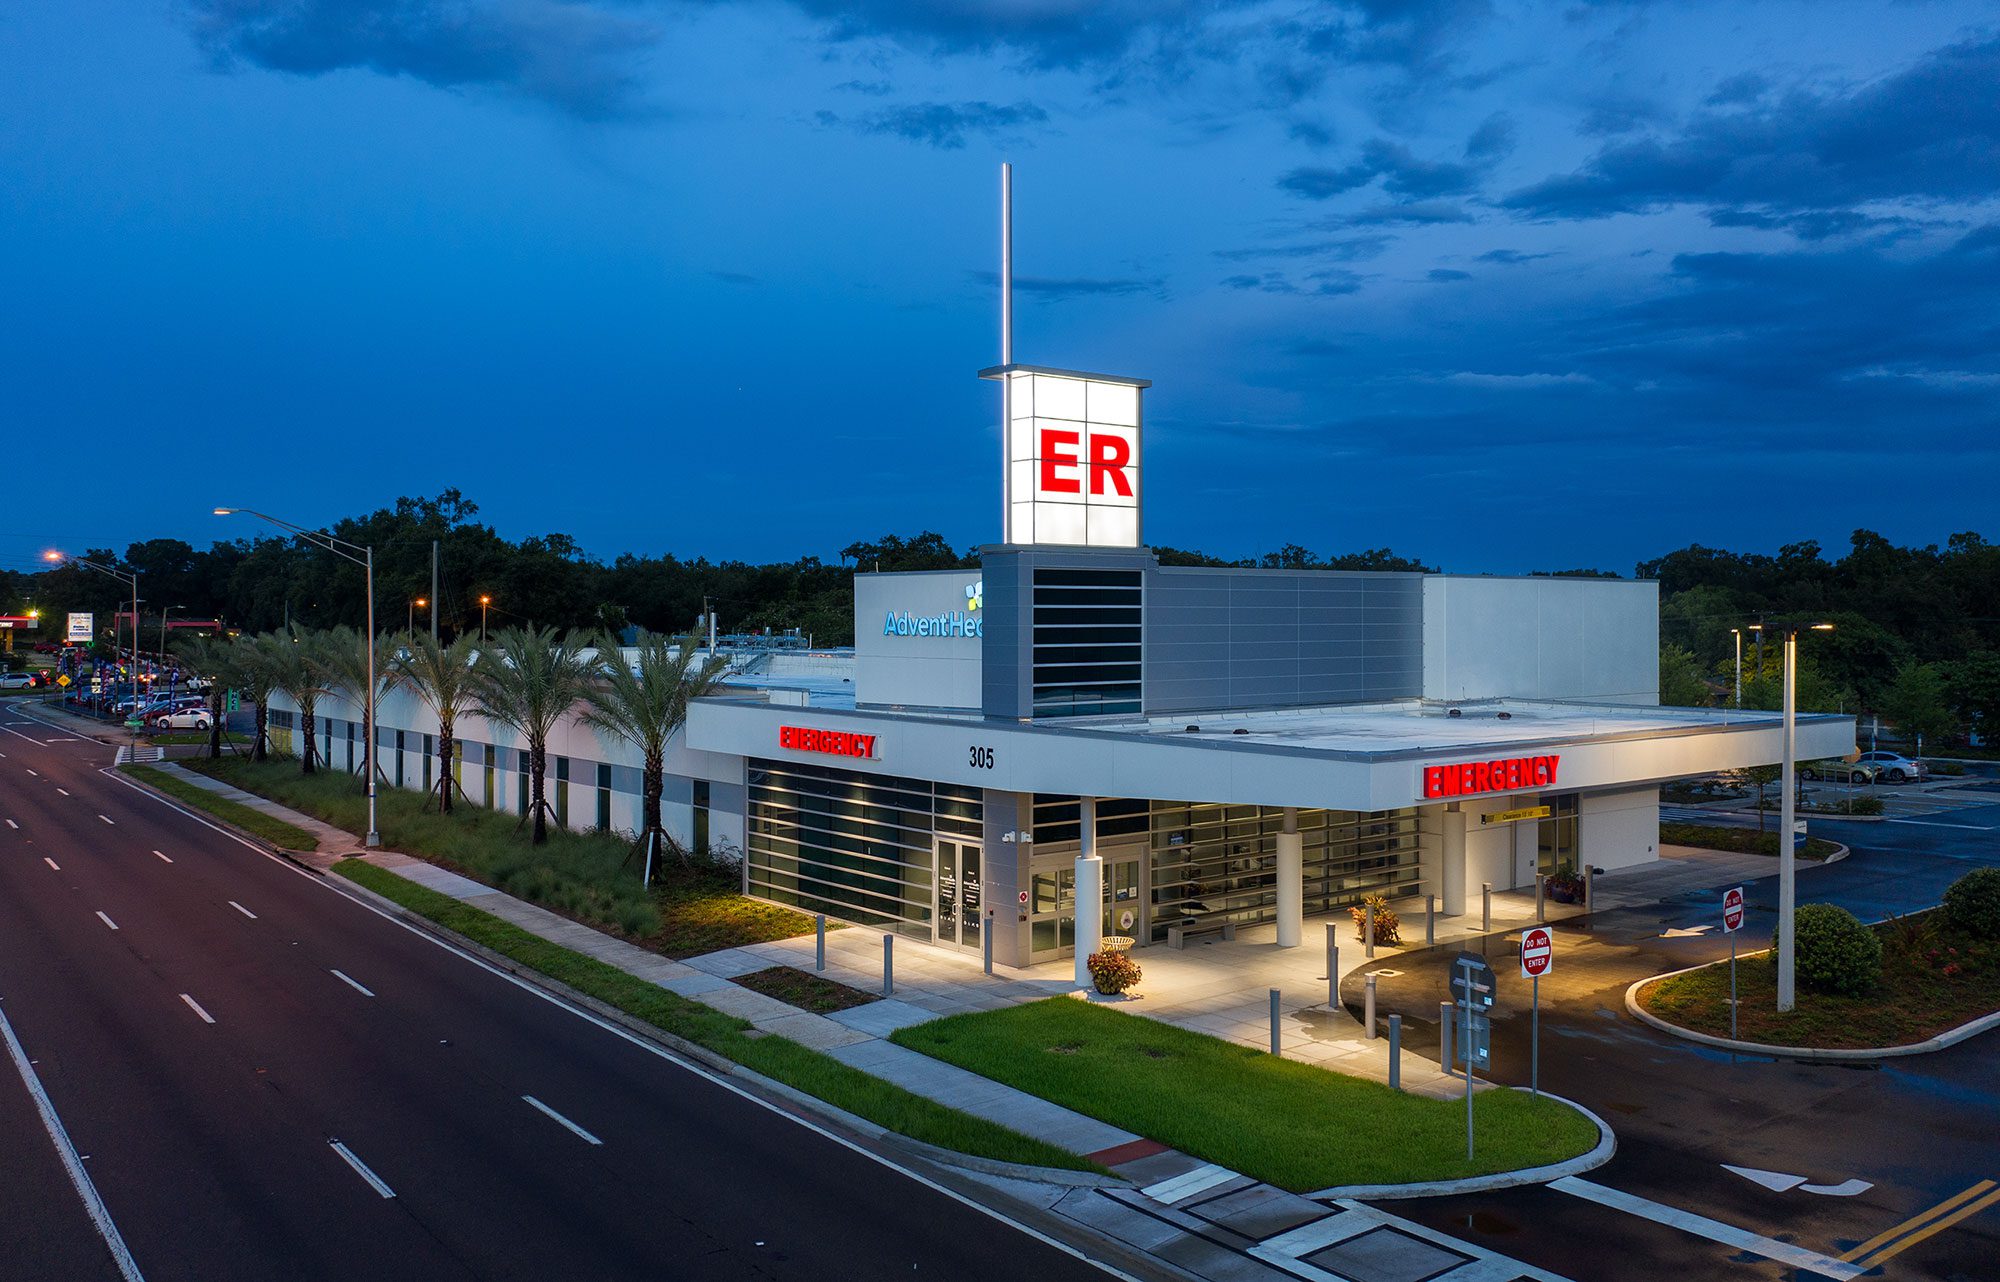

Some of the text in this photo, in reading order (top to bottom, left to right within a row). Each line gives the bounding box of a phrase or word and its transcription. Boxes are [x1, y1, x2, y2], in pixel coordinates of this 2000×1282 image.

[1041, 428, 1133, 497] ER
[780, 725, 876, 758] EMERGENCY
[969, 745, 994, 770] 305
[1424, 755, 1560, 798] EMERGENCY
[1726, 896, 1740, 907] DO NOT
[1727, 914, 1739, 924] ENTER
[1526, 937, 1547, 948] DO NOT
[1528, 958, 1545, 968] ENTER
